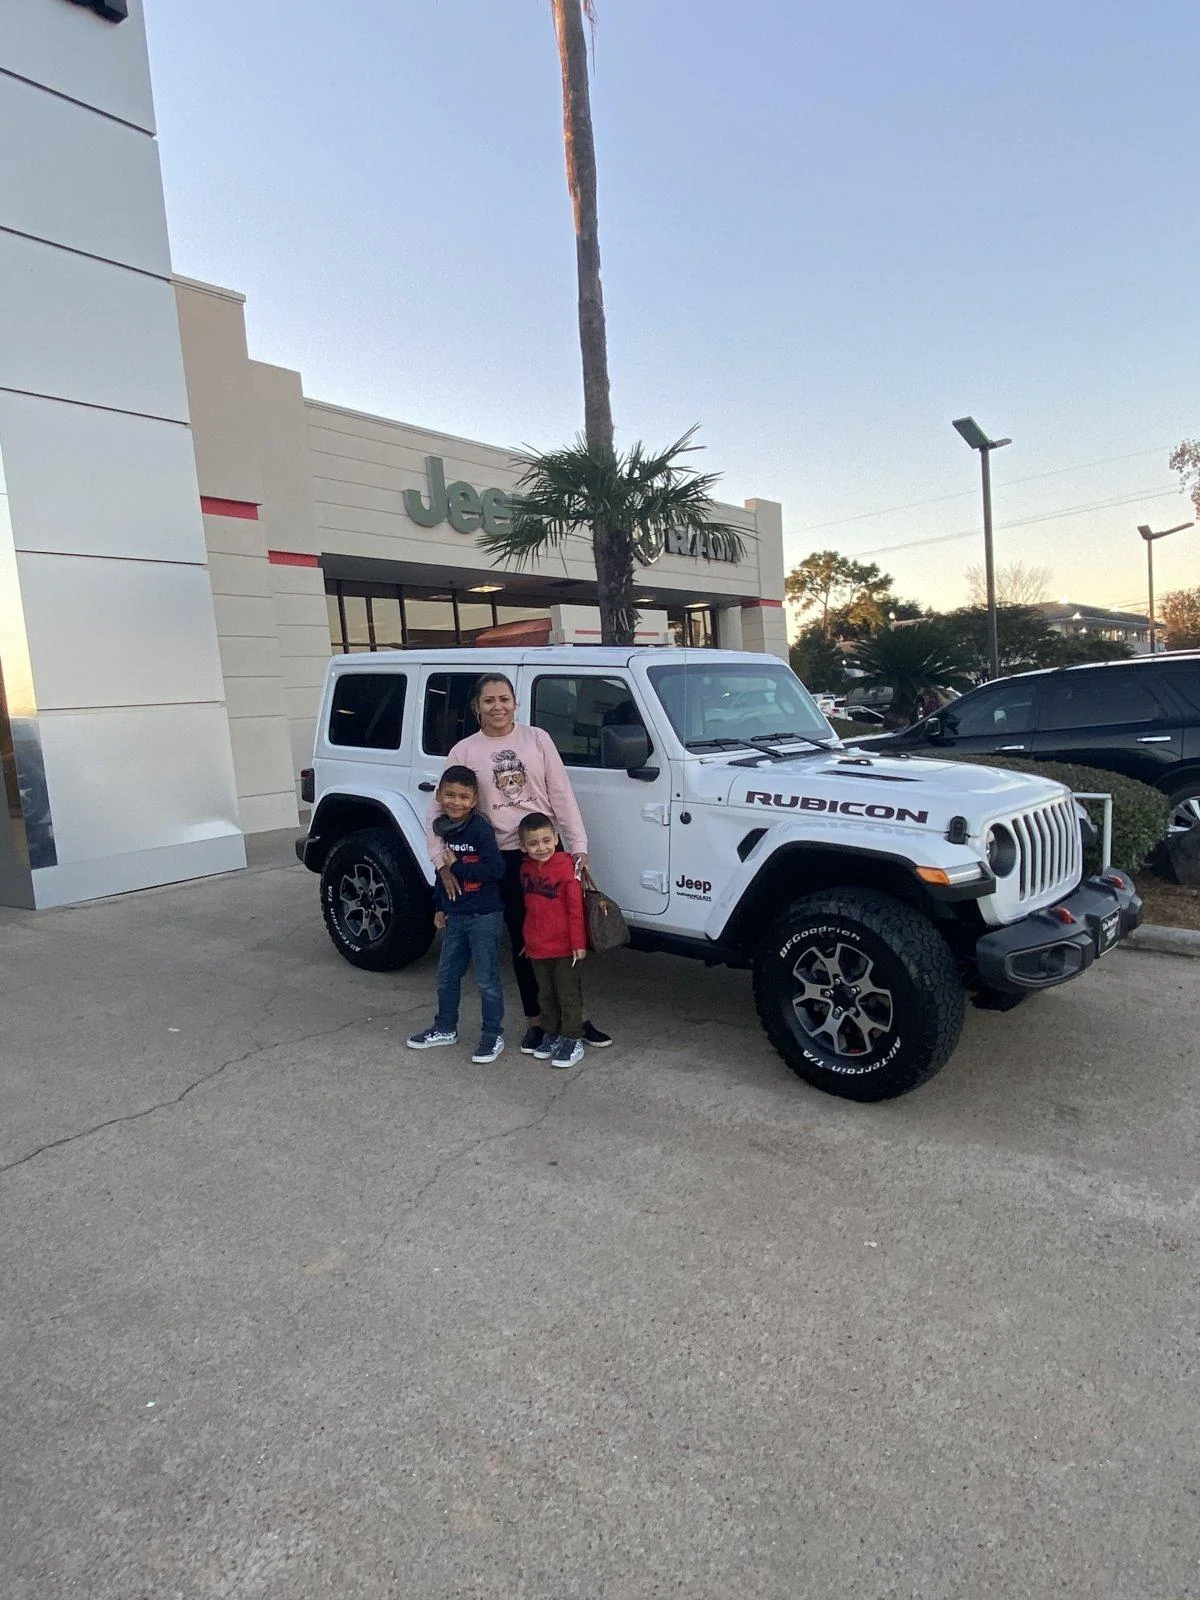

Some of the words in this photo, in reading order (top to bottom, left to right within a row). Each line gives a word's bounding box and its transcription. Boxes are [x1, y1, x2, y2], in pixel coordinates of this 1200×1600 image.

[402, 456, 522, 535] Jee
[745, 790, 929, 824] RUBICON
[675, 874, 712, 893] Jeep
